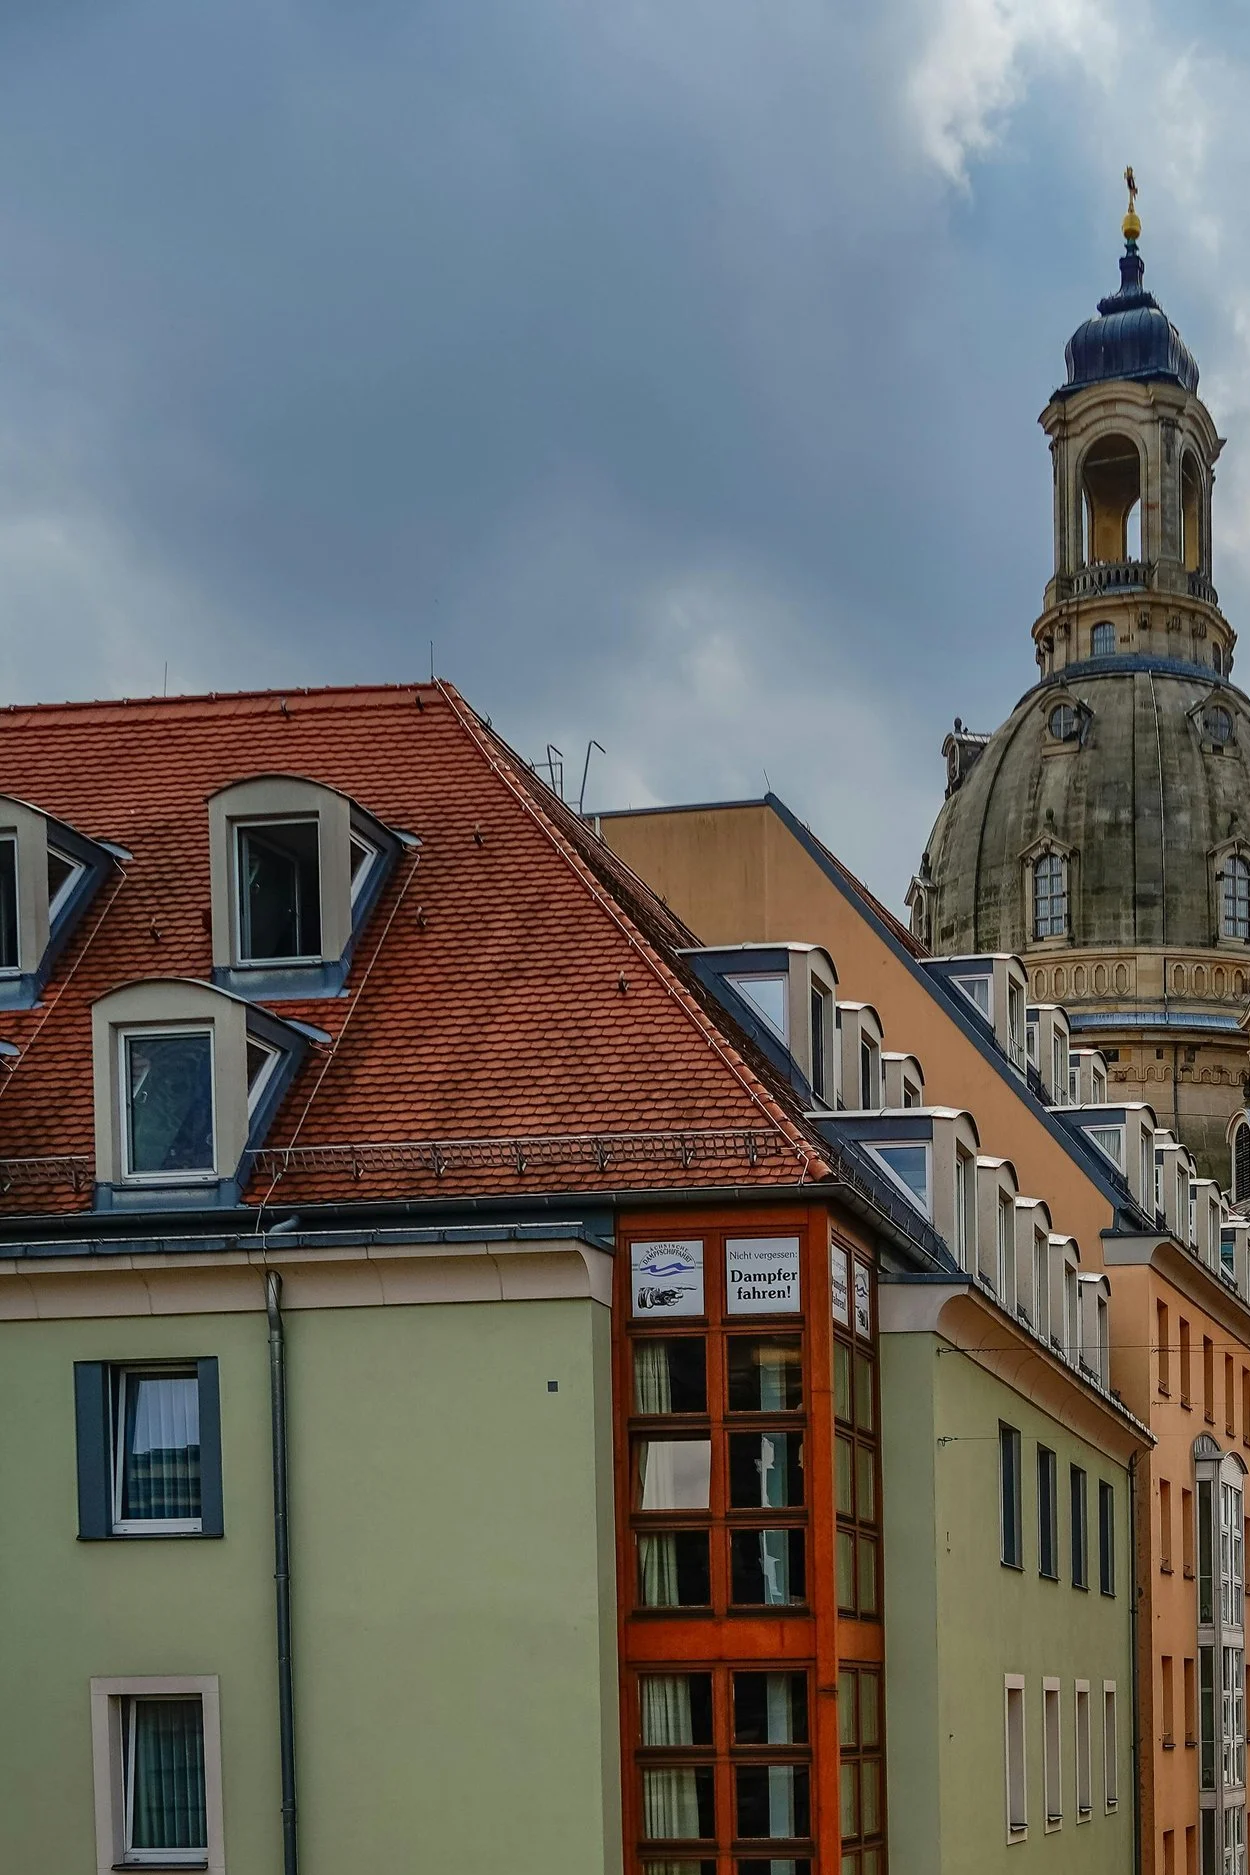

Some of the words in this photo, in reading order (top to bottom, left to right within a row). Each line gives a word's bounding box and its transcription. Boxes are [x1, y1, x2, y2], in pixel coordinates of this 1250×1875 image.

[729, 1250, 752, 1260] Nicht
[754, 1251, 798, 1262] vergessen:
[730, 1268, 798, 1284] Dampfer
[736, 1285, 791, 1300] fahren!
